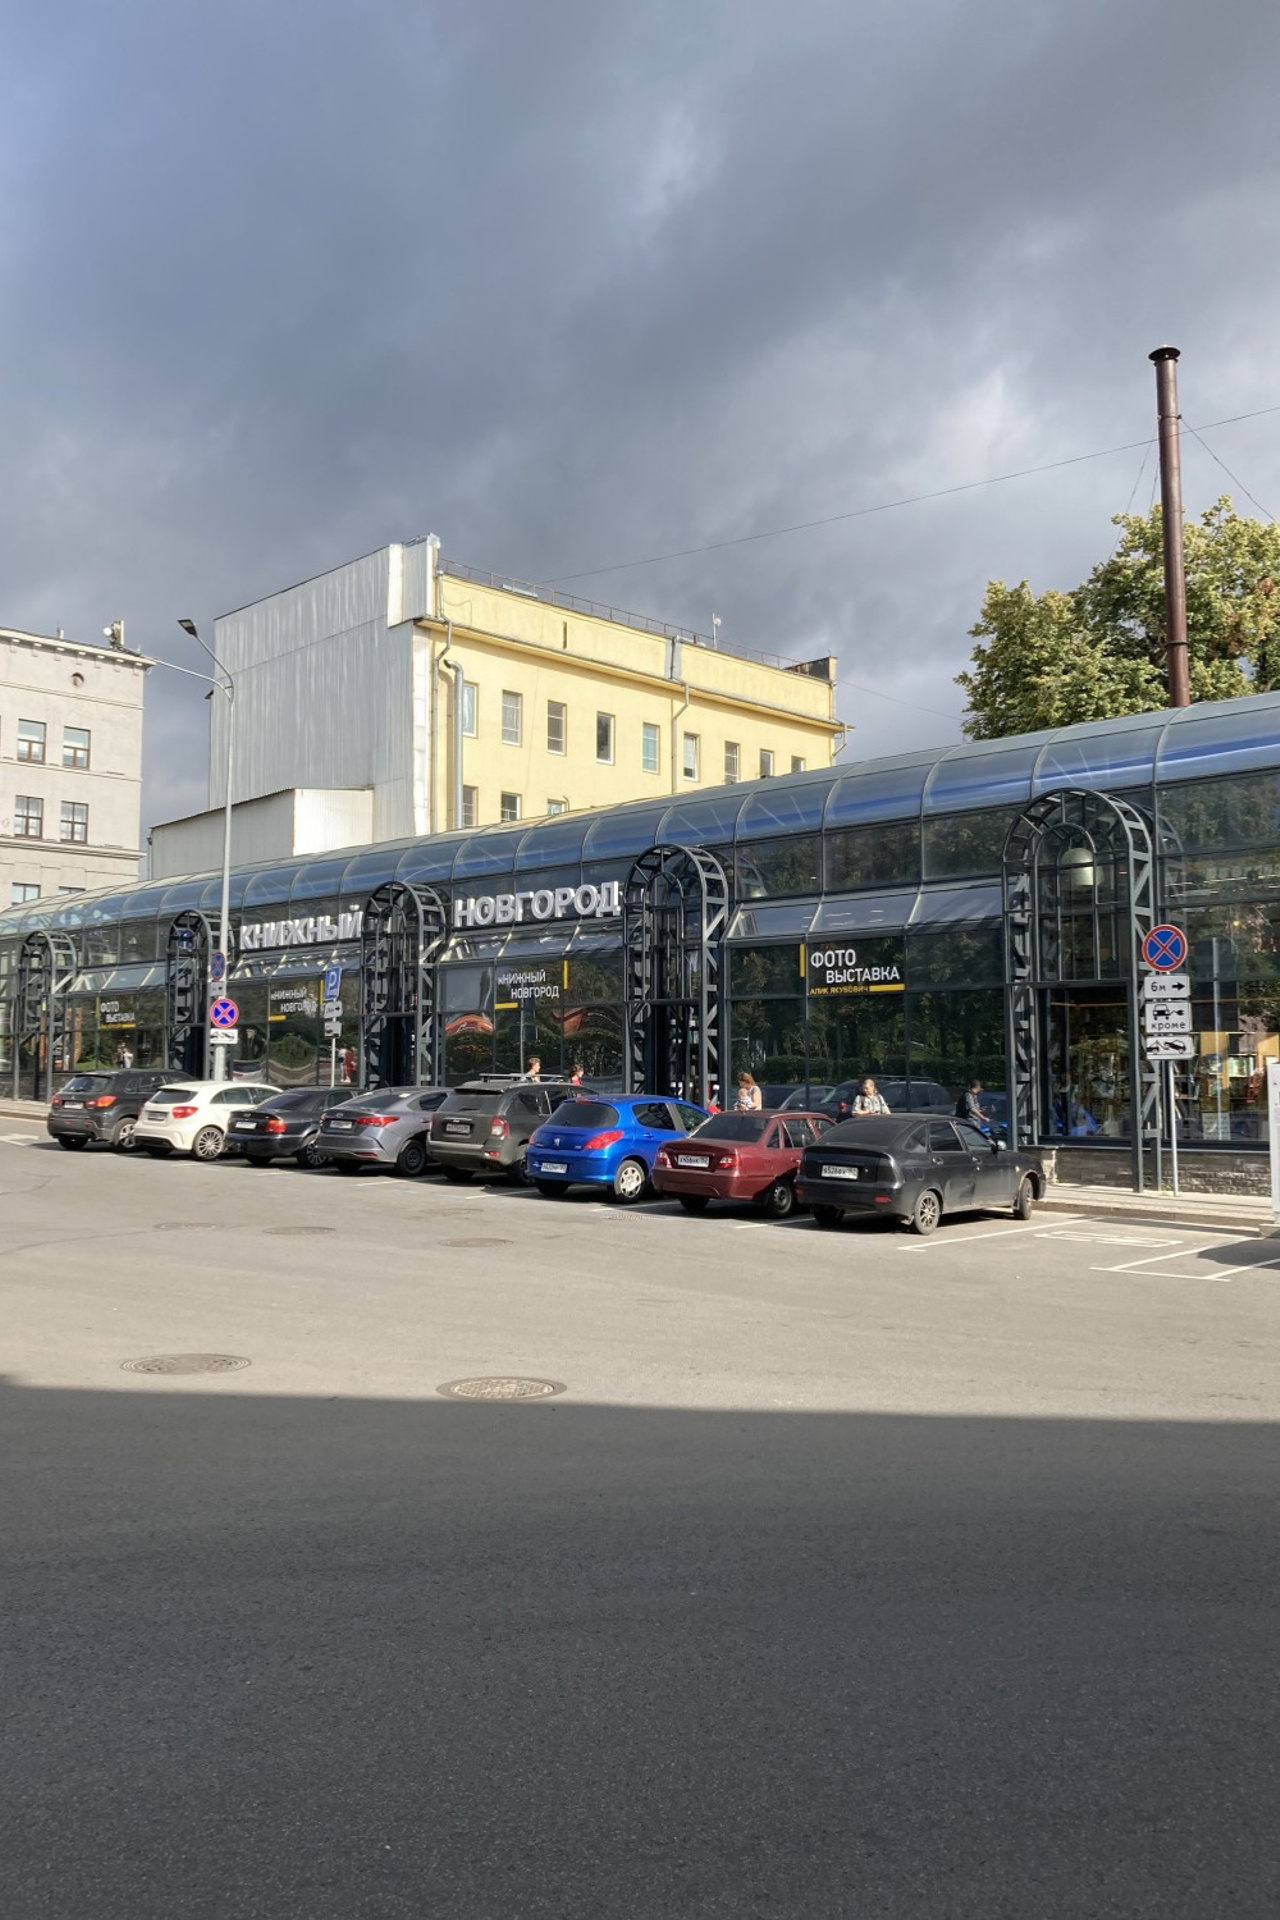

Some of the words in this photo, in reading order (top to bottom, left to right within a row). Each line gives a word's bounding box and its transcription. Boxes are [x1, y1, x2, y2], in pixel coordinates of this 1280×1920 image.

[453, 881, 621, 928] НОВГОРОД
[240, 904, 363, 950] КНИЖНЫЙ
[810, 949, 856, 968] ФОТО
[826, 966, 900, 983] ВЫСТАВКА
[511, 985, 560, 1000] НОВГОРОД
[1151, 1022, 1186, 1031] кроме
